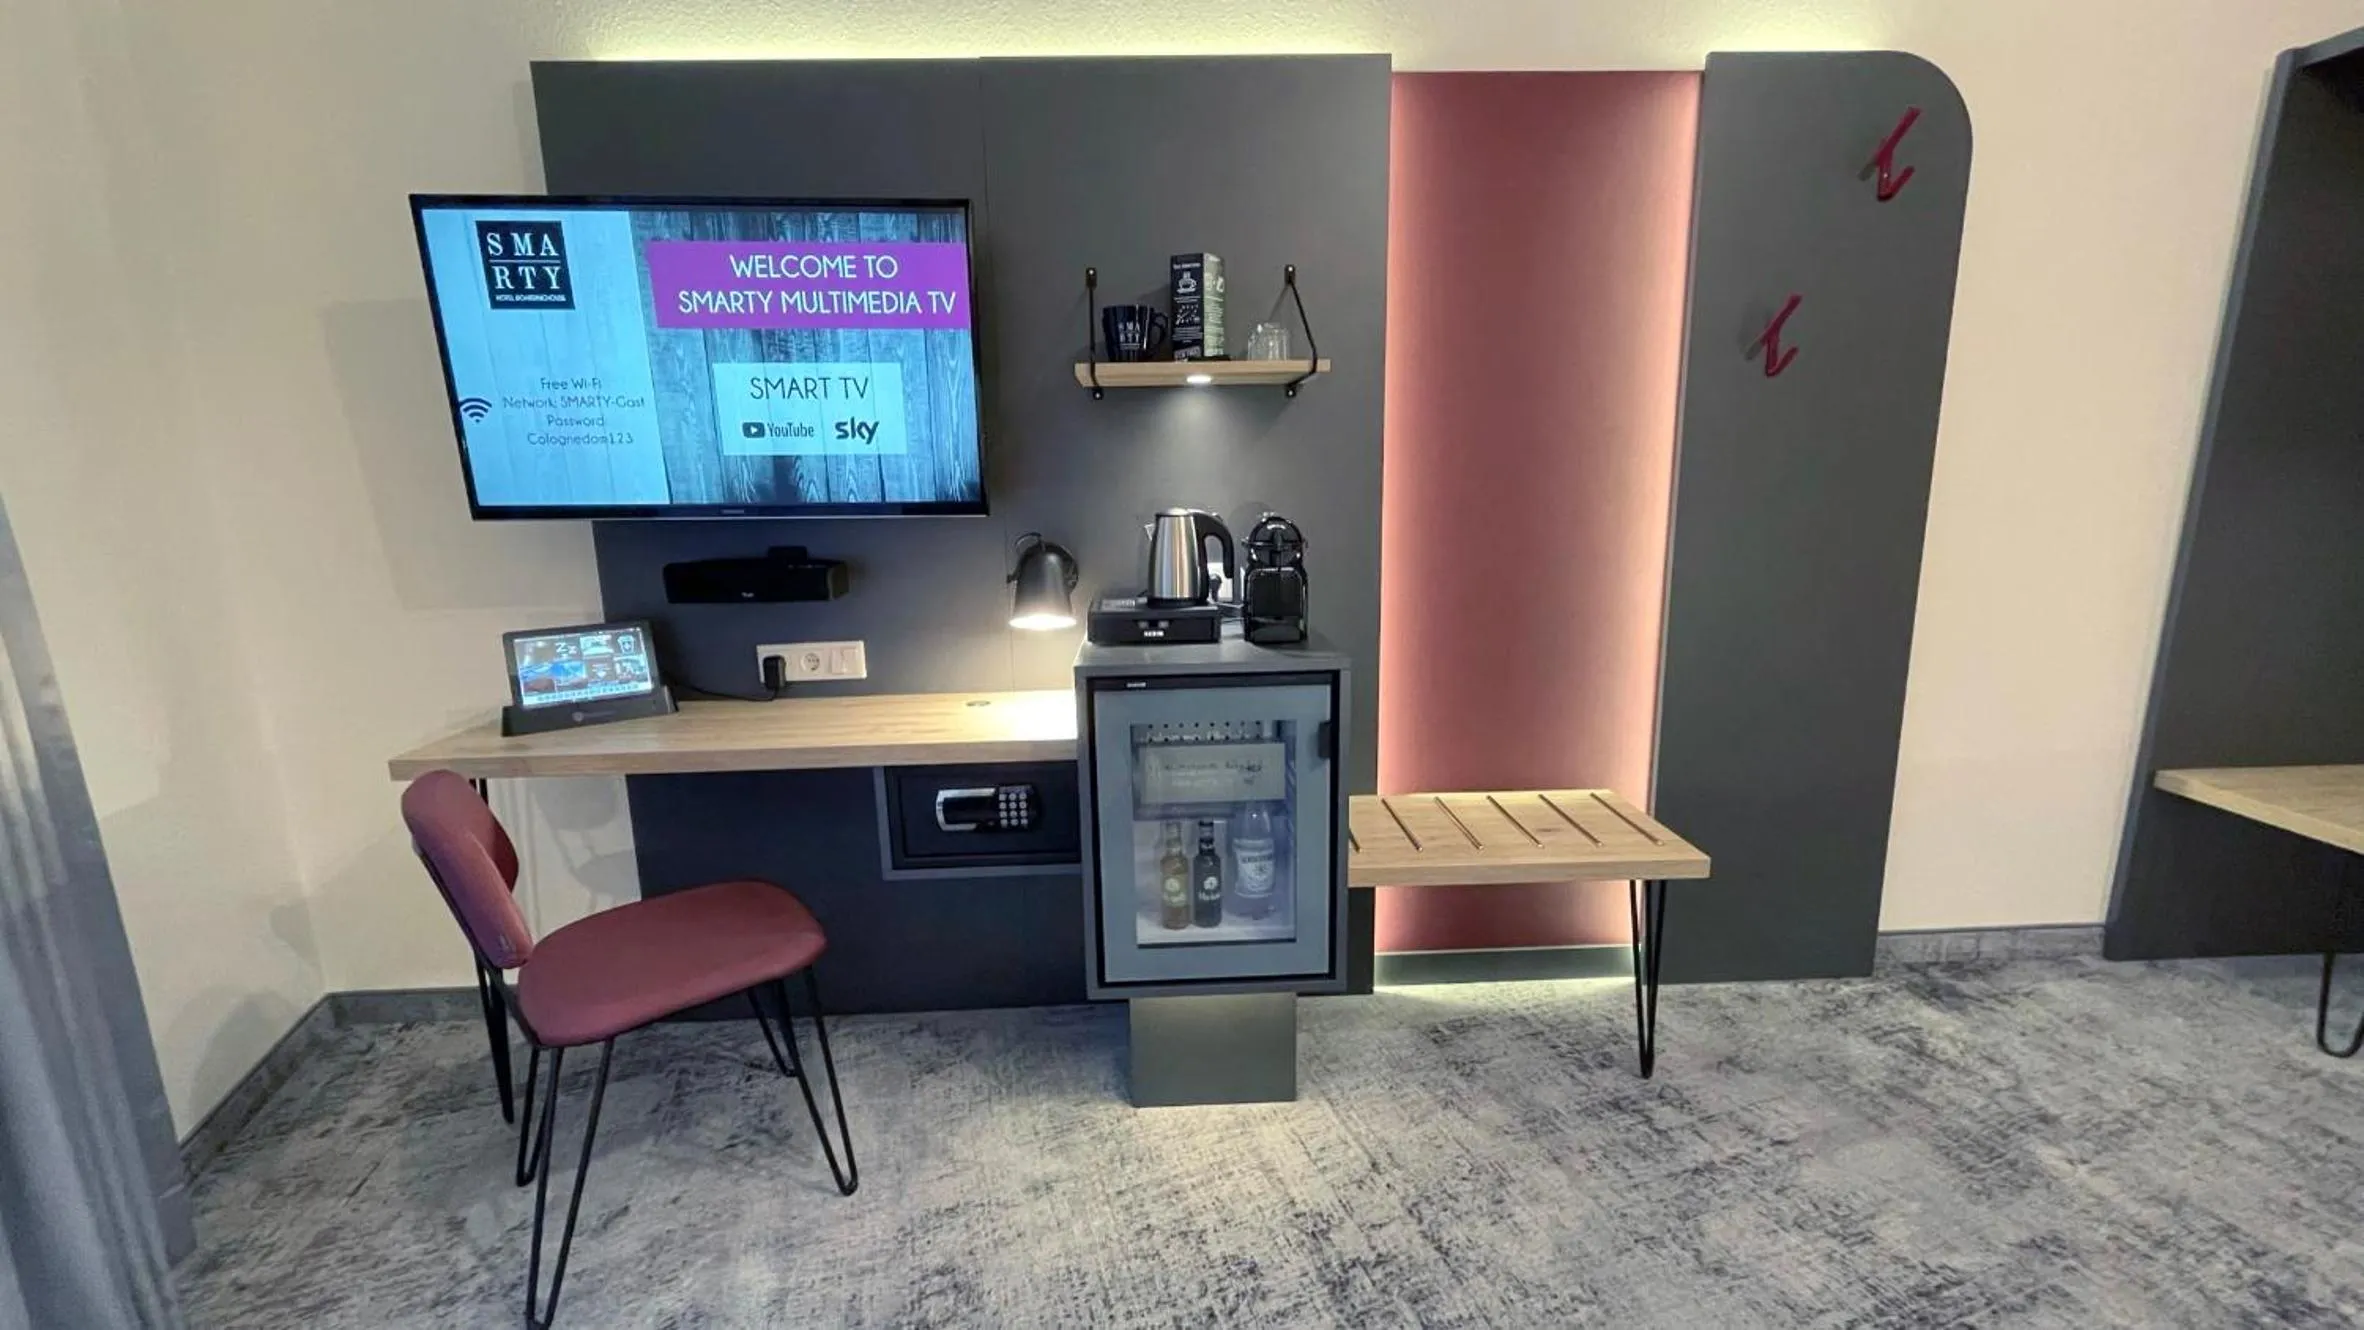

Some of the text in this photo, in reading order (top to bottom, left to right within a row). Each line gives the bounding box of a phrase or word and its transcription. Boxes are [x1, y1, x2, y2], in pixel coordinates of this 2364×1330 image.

[729, 254, 898, 278] WELCOME TO
[678, 290, 956, 314] SMARTY MULTIMEDIA TV
[540, 378, 602, 390] Free Wi-Fi
[750, 376, 869, 400] SMART TV
[767, 415, 880, 445] YouTube sky
